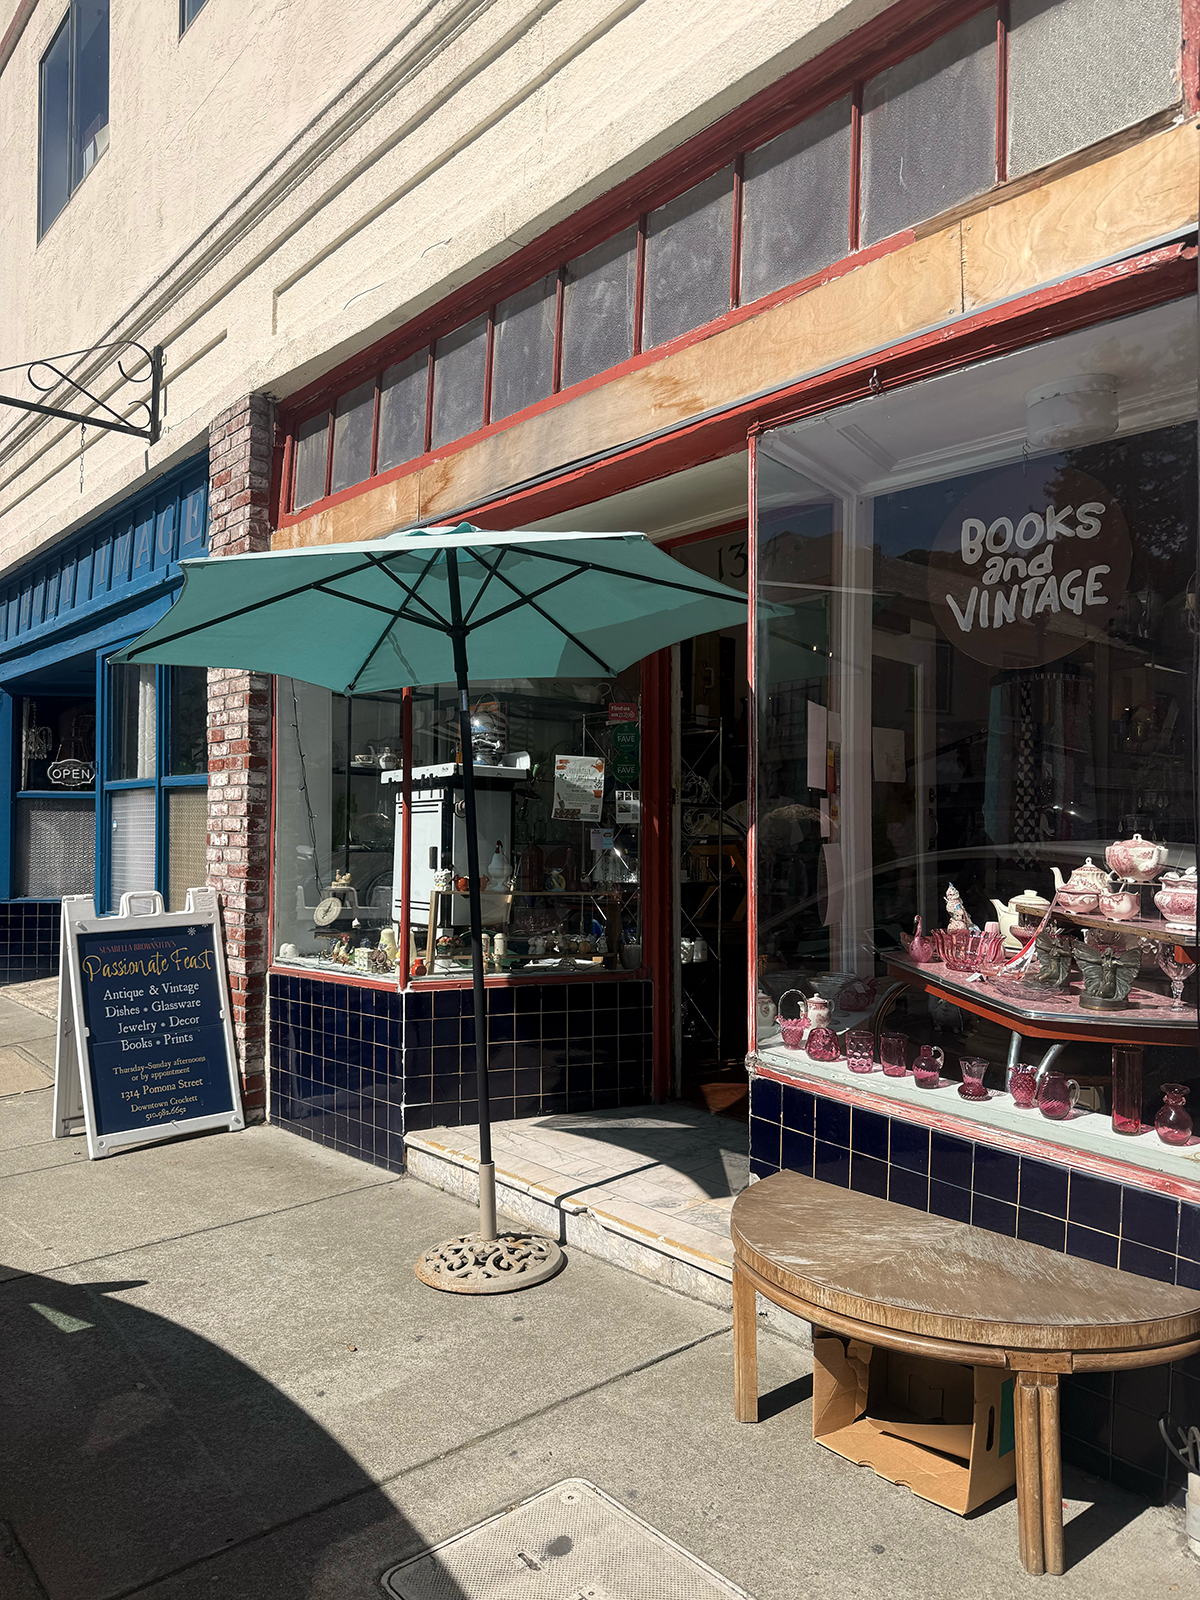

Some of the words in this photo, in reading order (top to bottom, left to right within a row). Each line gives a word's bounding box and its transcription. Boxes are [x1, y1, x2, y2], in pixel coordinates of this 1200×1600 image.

[97, 485, 205, 586] IMAGE
[961, 502, 1106, 564] BOOKS
[982, 544, 1054, 585] and
[945, 564, 1111, 632] VINTAGE
[617, 735, 636, 743] FAVE
[52, 768, 90, 779] OPEN
[617, 766, 636, 774] FAVE
[82, 951, 169, 982] Passionate
[170, 947, 214, 971] Feast
[103, 987, 144, 1001] Antique
[149, 985, 159, 995] &
[161, 981, 200, 995] Vintage
[105, 1005, 140, 1018] Dishes
[151, 999, 201, 1012] Glassware
[117, 1020, 157, 1034] Jewelry
[169, 1015, 200, 1028] Decor
[121, 1037, 153, 1051] Books
[163, 1032, 194, 1045] Prints
[112, 1060, 171, 1075] Thursday-Sunday
[173, 1056, 206, 1067] afternoons
[140, 1071, 149, 1082] by
[151, 1067, 190, 1080] appointment
[121, 1089, 140, 1101] 1314
[142, 1083, 176, 1095] Pomona
[177, 1078, 203, 1089] Street
[130, 1100, 168, 1112] Downtown
[169, 1095, 198, 1106] Crockett
